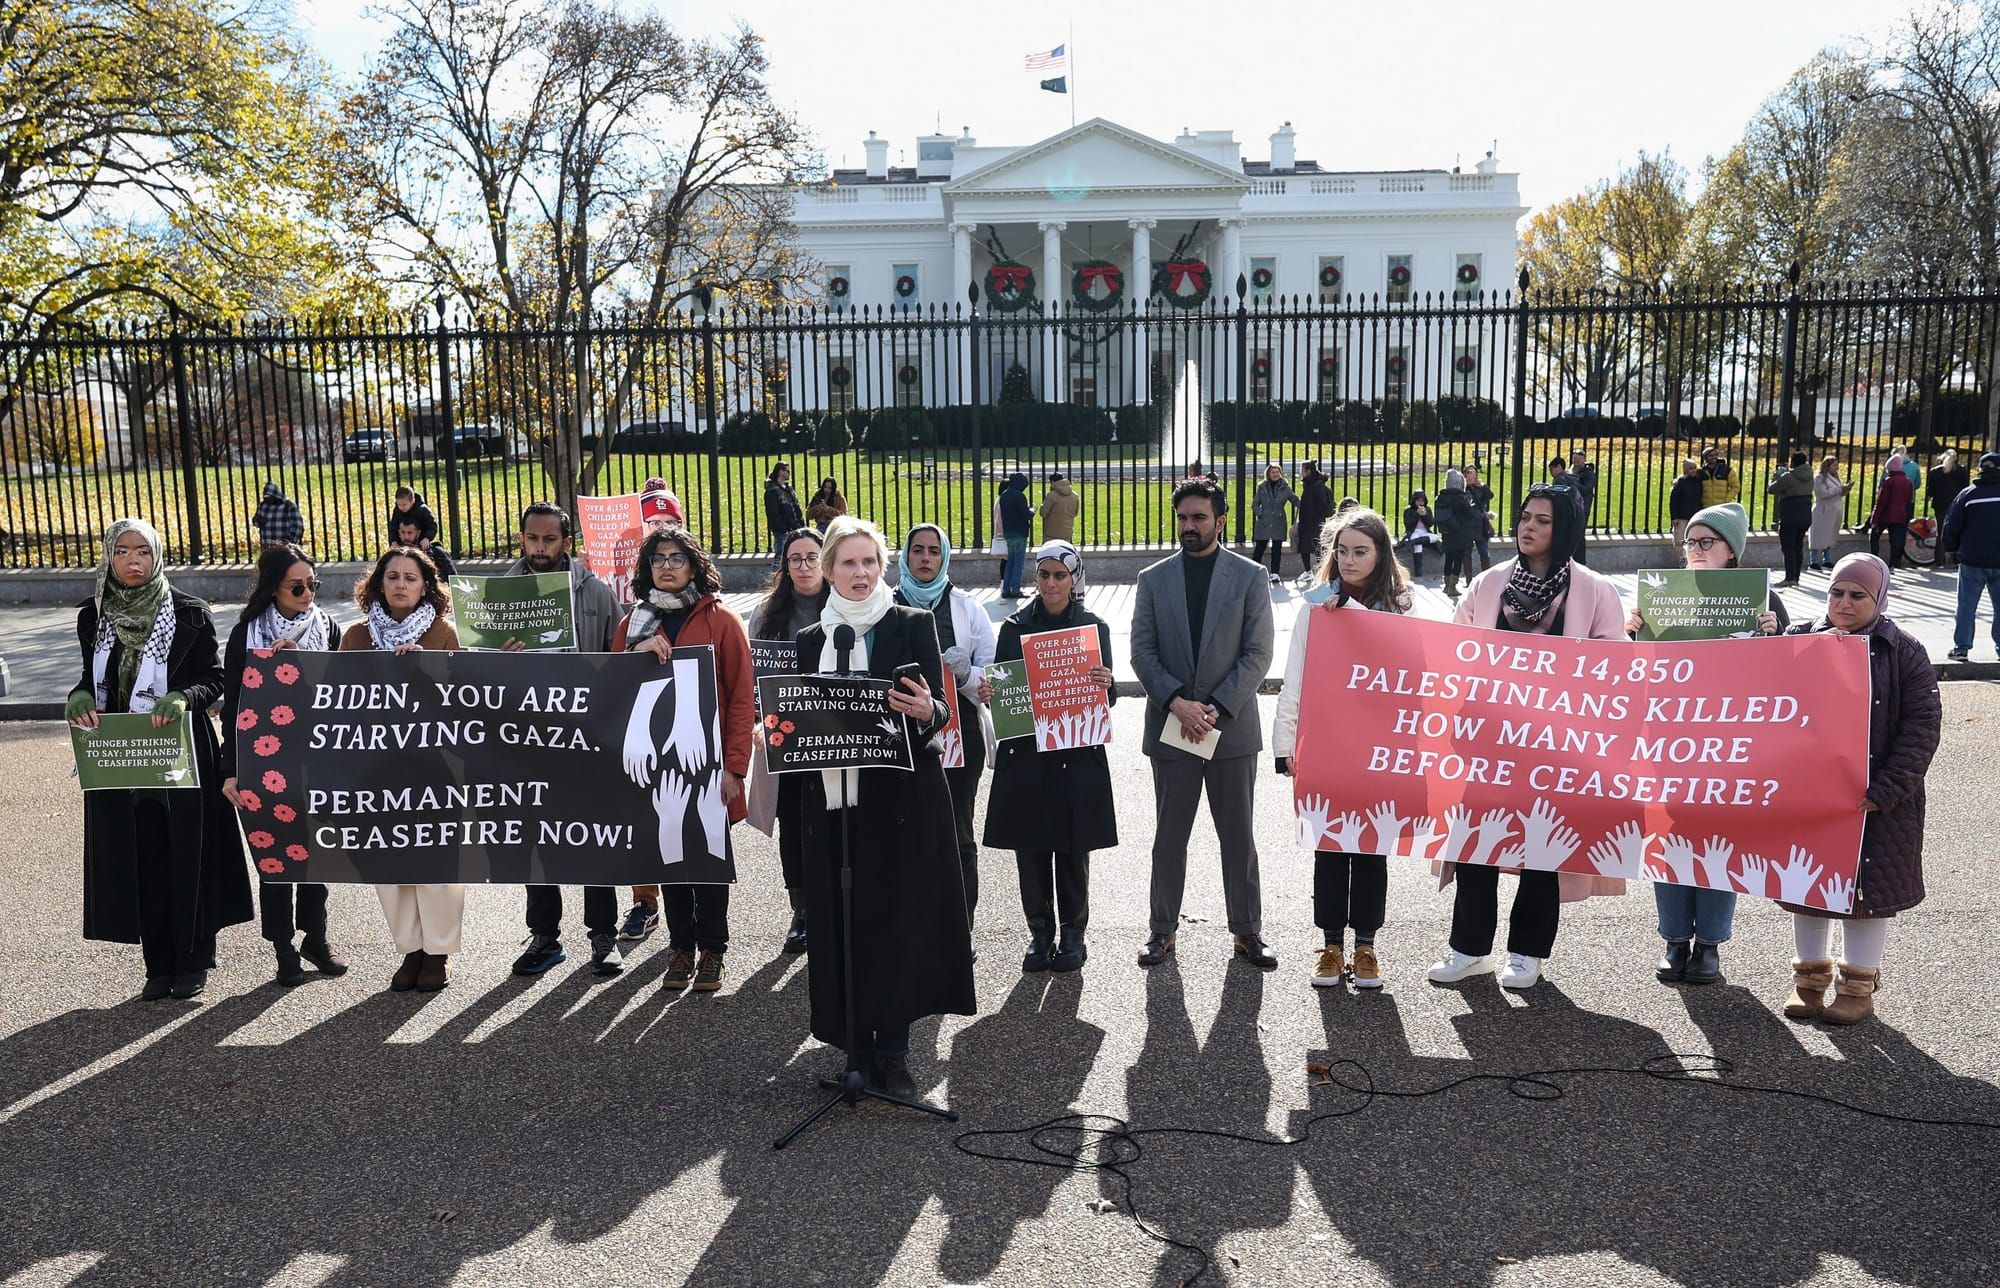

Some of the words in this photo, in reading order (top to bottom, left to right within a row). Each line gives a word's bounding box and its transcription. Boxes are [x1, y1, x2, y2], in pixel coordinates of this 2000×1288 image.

[585, 504, 604, 512] OVER
[606, 503, 629, 512] 6,150
[610, 540, 635, 548] MANY
[466, 602, 506, 610] HUNGER
[509, 598, 556, 610] STRIKING
[1652, 597, 1695, 605] HUNGER
[1698, 597, 1750, 605] STRIKING
[464, 611, 478, 619] TO
[480, 611, 500, 620] SAY:
[502, 608, 564, 621] PERMANENT
[1648, 608, 1661, 616] TO
[1664, 608, 1686, 616] SAY:
[1690, 608, 1757, 616] PERMANENT
[474, 621, 525, 630] CEASEFIRE
[528, 619, 555, 628] NOW!
[1717, 619, 1746, 627] NOW!
[1034, 639, 1059, 650] OVER
[1062, 635, 1086, 646] 6,150
[751, 648, 772, 658] DEN,
[778, 650, 797, 658] YOU
[1037, 646, 1087, 659] CHILDREN
[752, 659, 788, 668] RVING
[1039, 660, 1073, 669] KILLED
[1077, 656, 1088, 664] IN
[1455, 640, 1558, 676] OVER
[1570, 654, 1695, 687] 14,850
[1039, 680, 1061, 689] HOW
[1065, 676, 1092, 686] MANY
[778, 686, 824, 698] BIDEN,
[828, 688, 854, 698] YOU
[860, 690, 884, 700] ARE
[1002, 685, 1029, 696] HUNG
[1035, 690, 1062, 700] MORE
[1065, 684, 1101, 695] BEFORE
[1346, 664, 1629, 721] PALESTINIANS
[1644, 694, 1811, 728] KILLED,
[311, 683, 420, 714] BIDEN,
[434, 683, 506, 709] YOU
[518, 686, 591, 714] ARE
[1000, 698, 1012, 706] TO
[1042, 695, 1098, 709] CEASEFIRE?
[778, 701, 846, 713] STARVING
[850, 703, 888, 714] GAZA.
[308, 720, 486, 750] STARVING
[499, 723, 601, 752] GAZA.
[797, 735, 881, 747] PERMANENT
[1392, 708, 1486, 741] HOW
[1496, 720, 1619, 757] MANY
[1631, 736, 1753, 765] MORE
[88, 740, 128, 748] HUNGER
[130, 738, 177, 746] STRIKING
[86, 750, 100, 758] TO
[102, 749, 122, 758] SAY:
[125, 747, 185, 757] PERMANENT
[783, 748, 858, 762] CEASEFIRE
[863, 748, 897, 759] NOW!
[97, 759, 149, 767] CEASEFIRE
[152, 758, 178, 766] NOW!
[1366, 746, 1515, 787] BEFORE
[1528, 764, 1780, 807] CEASEFIRE?
[308, 782, 550, 815] PERMANENT
[315, 820, 522, 850] CEASEFIRE
[537, 822, 634, 850] NOW!
